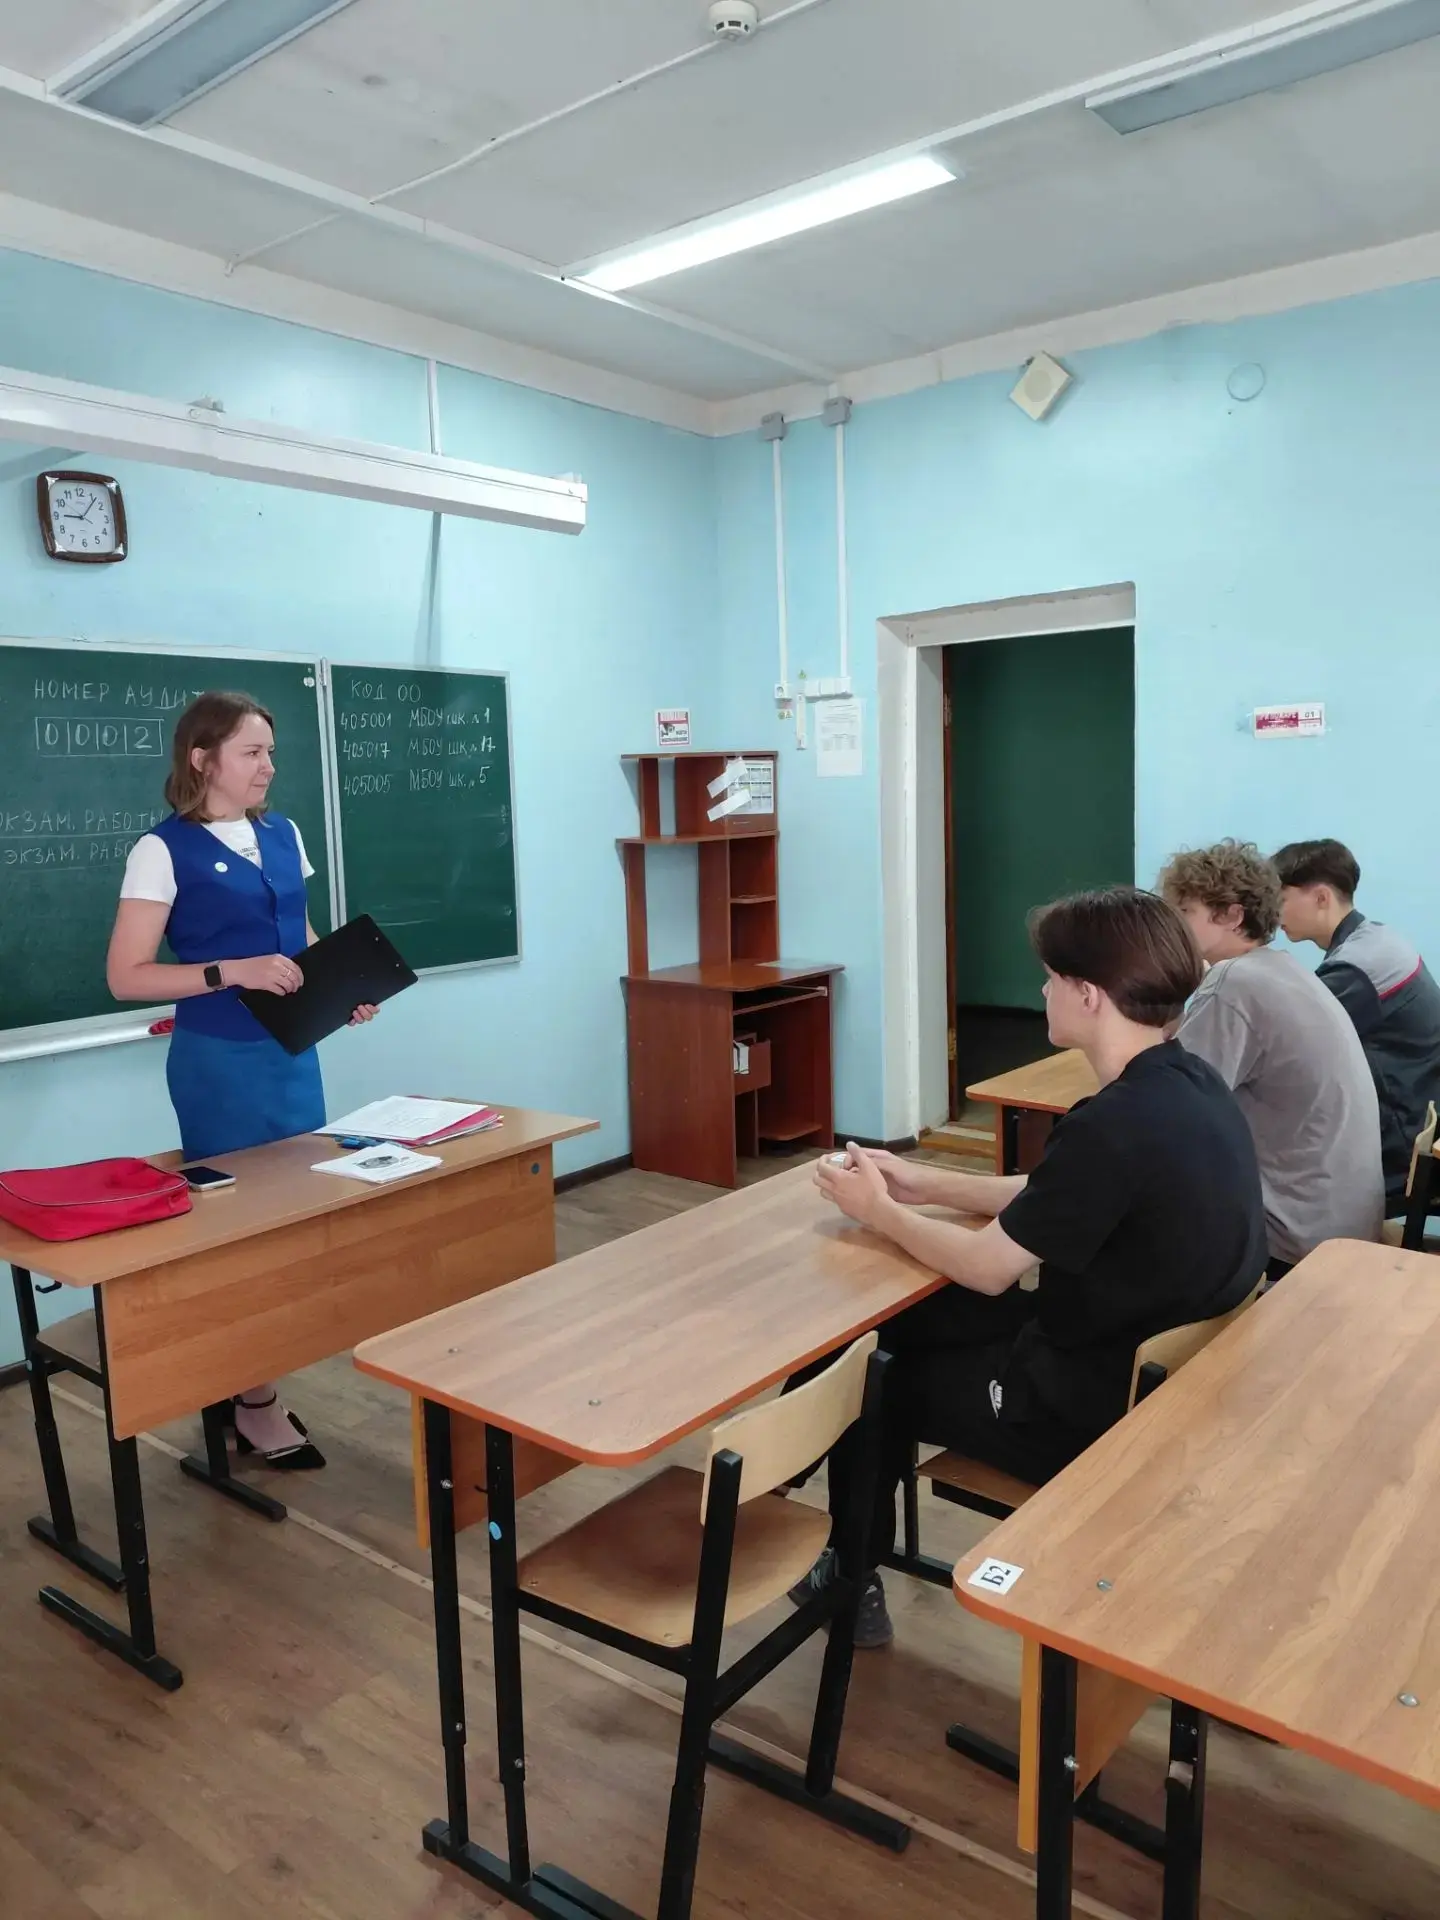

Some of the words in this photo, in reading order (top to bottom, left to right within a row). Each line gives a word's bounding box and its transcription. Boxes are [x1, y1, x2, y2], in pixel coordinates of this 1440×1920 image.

[64, 490, 72, 499] 11
[74, 487, 85, 498] 12
[56, 499, 66, 508] 10
[98, 502, 104, 511] 2
[54, 512, 60, 520] 9
[104, 515, 110, 524] 3
[60, 525, 66, 534] 8
[102, 528, 108, 536] 4
[70, 535, 75, 543] 7
[82, 539, 88, 547] 6
[95, 536, 101, 544] 5
[33, 678, 111, 702] НОМЕР
[351, 679, 387, 700] КОД
[340, 711, 392, 731] 405001
[409, 706, 444, 728] МБОУ
[343, 738, 392, 760] 405017
[407, 737, 444, 757] МБОУ
[481, 734, 497, 753] 17
[343, 772, 393, 797] 405005
[409, 767, 444, 791] МБОУ
[479, 765, 491, 784] 5
[4, 843, 81, 865] ЭКЗАМ.
[980, 1565, 1012, 1587] Б2
